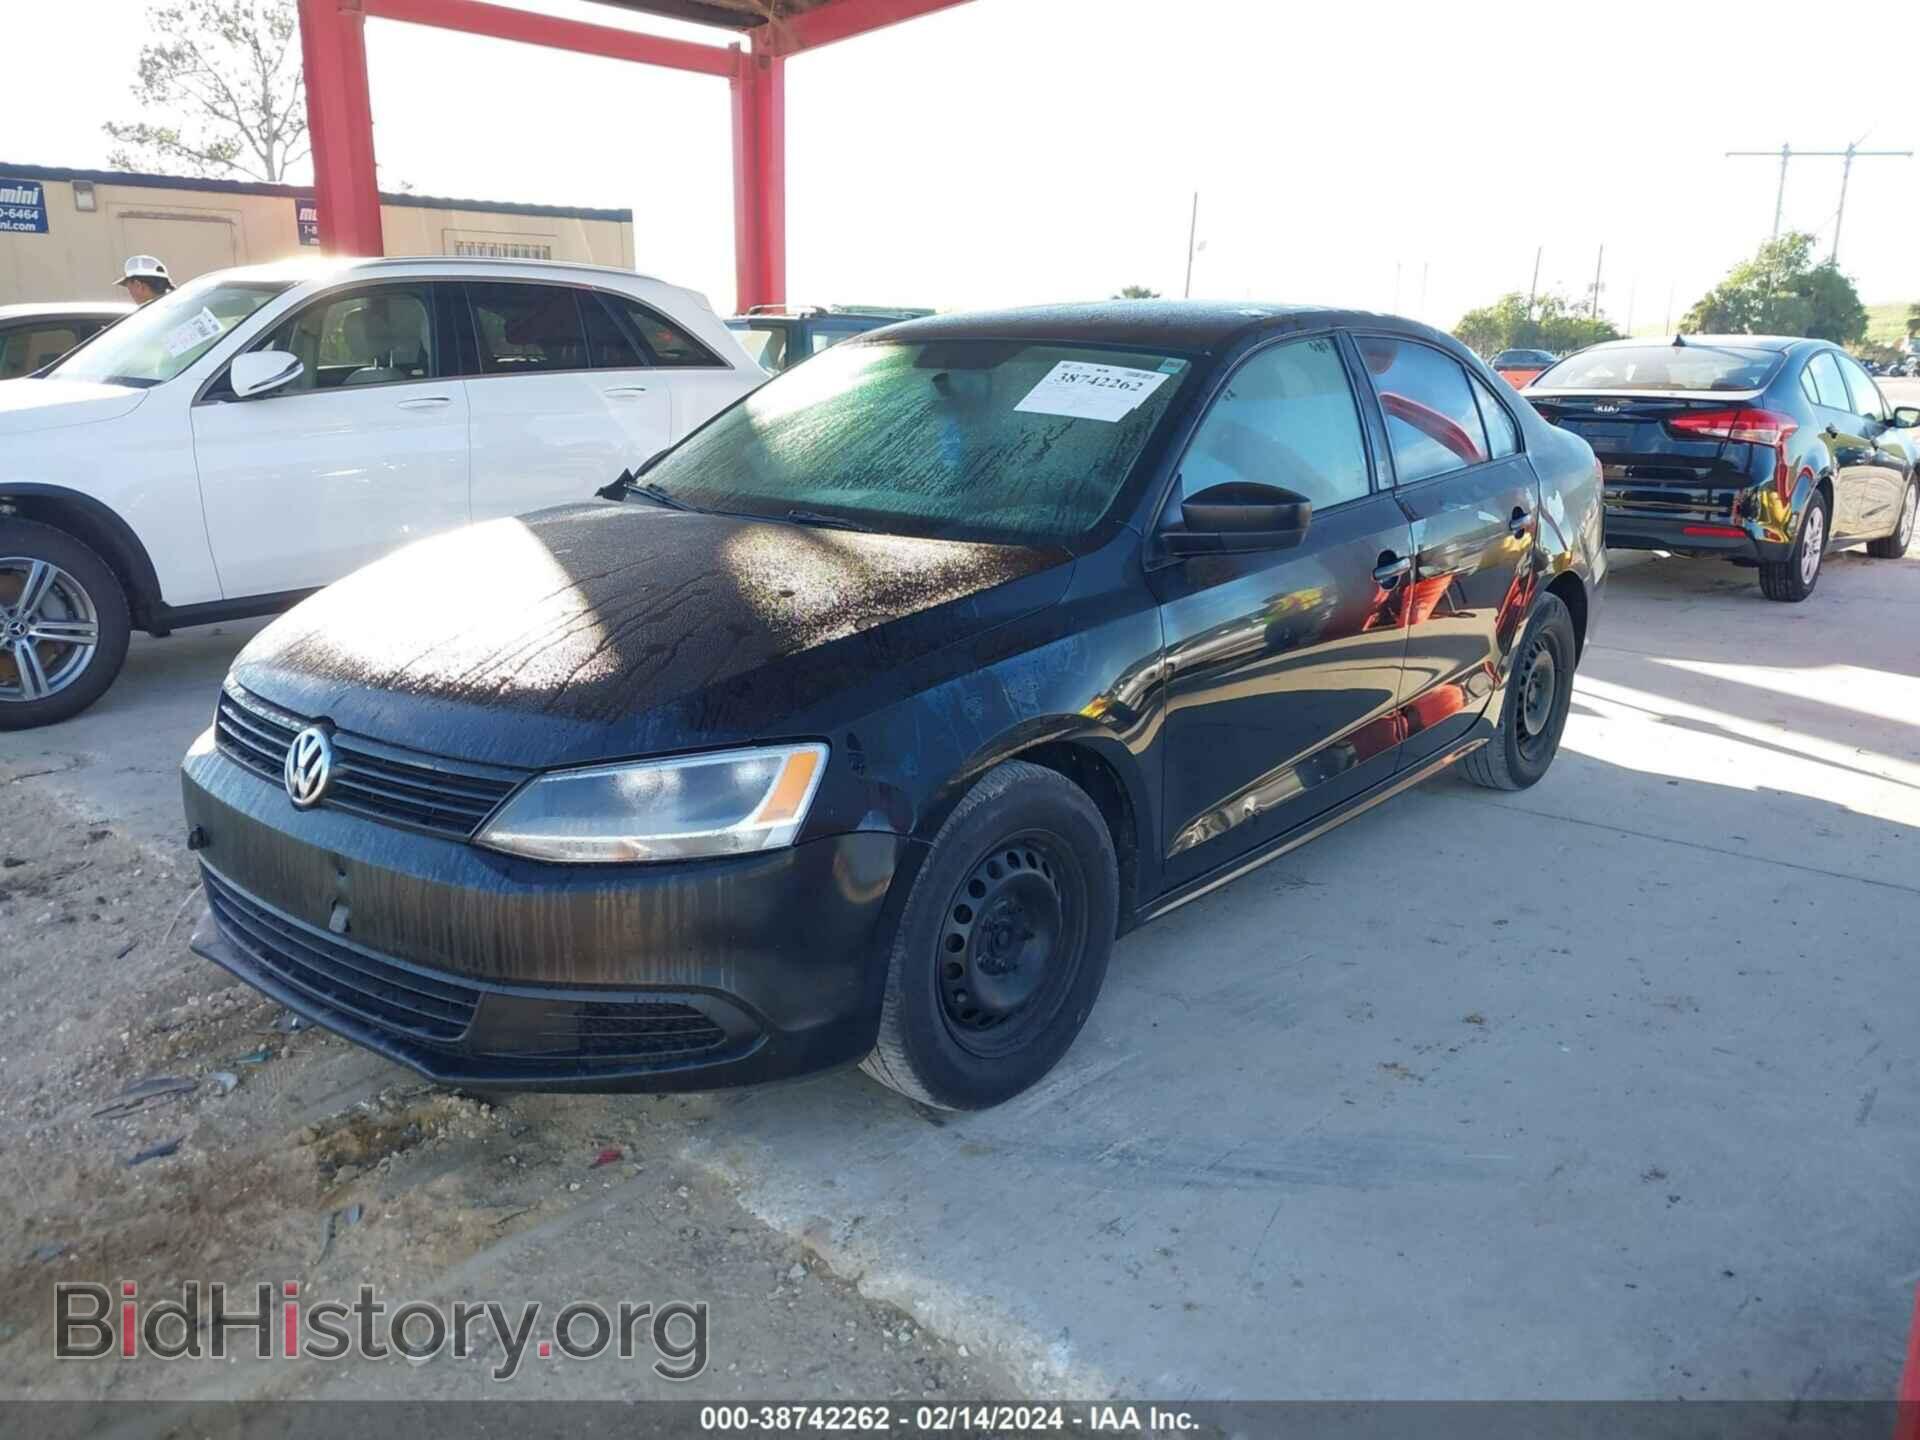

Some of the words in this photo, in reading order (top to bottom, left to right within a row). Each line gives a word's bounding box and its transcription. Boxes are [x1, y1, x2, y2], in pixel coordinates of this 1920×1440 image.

[0, 186, 39, 205] mini
[1054, 371, 1144, 392] 38742262
[1594, 404, 1620, 414] KIA
